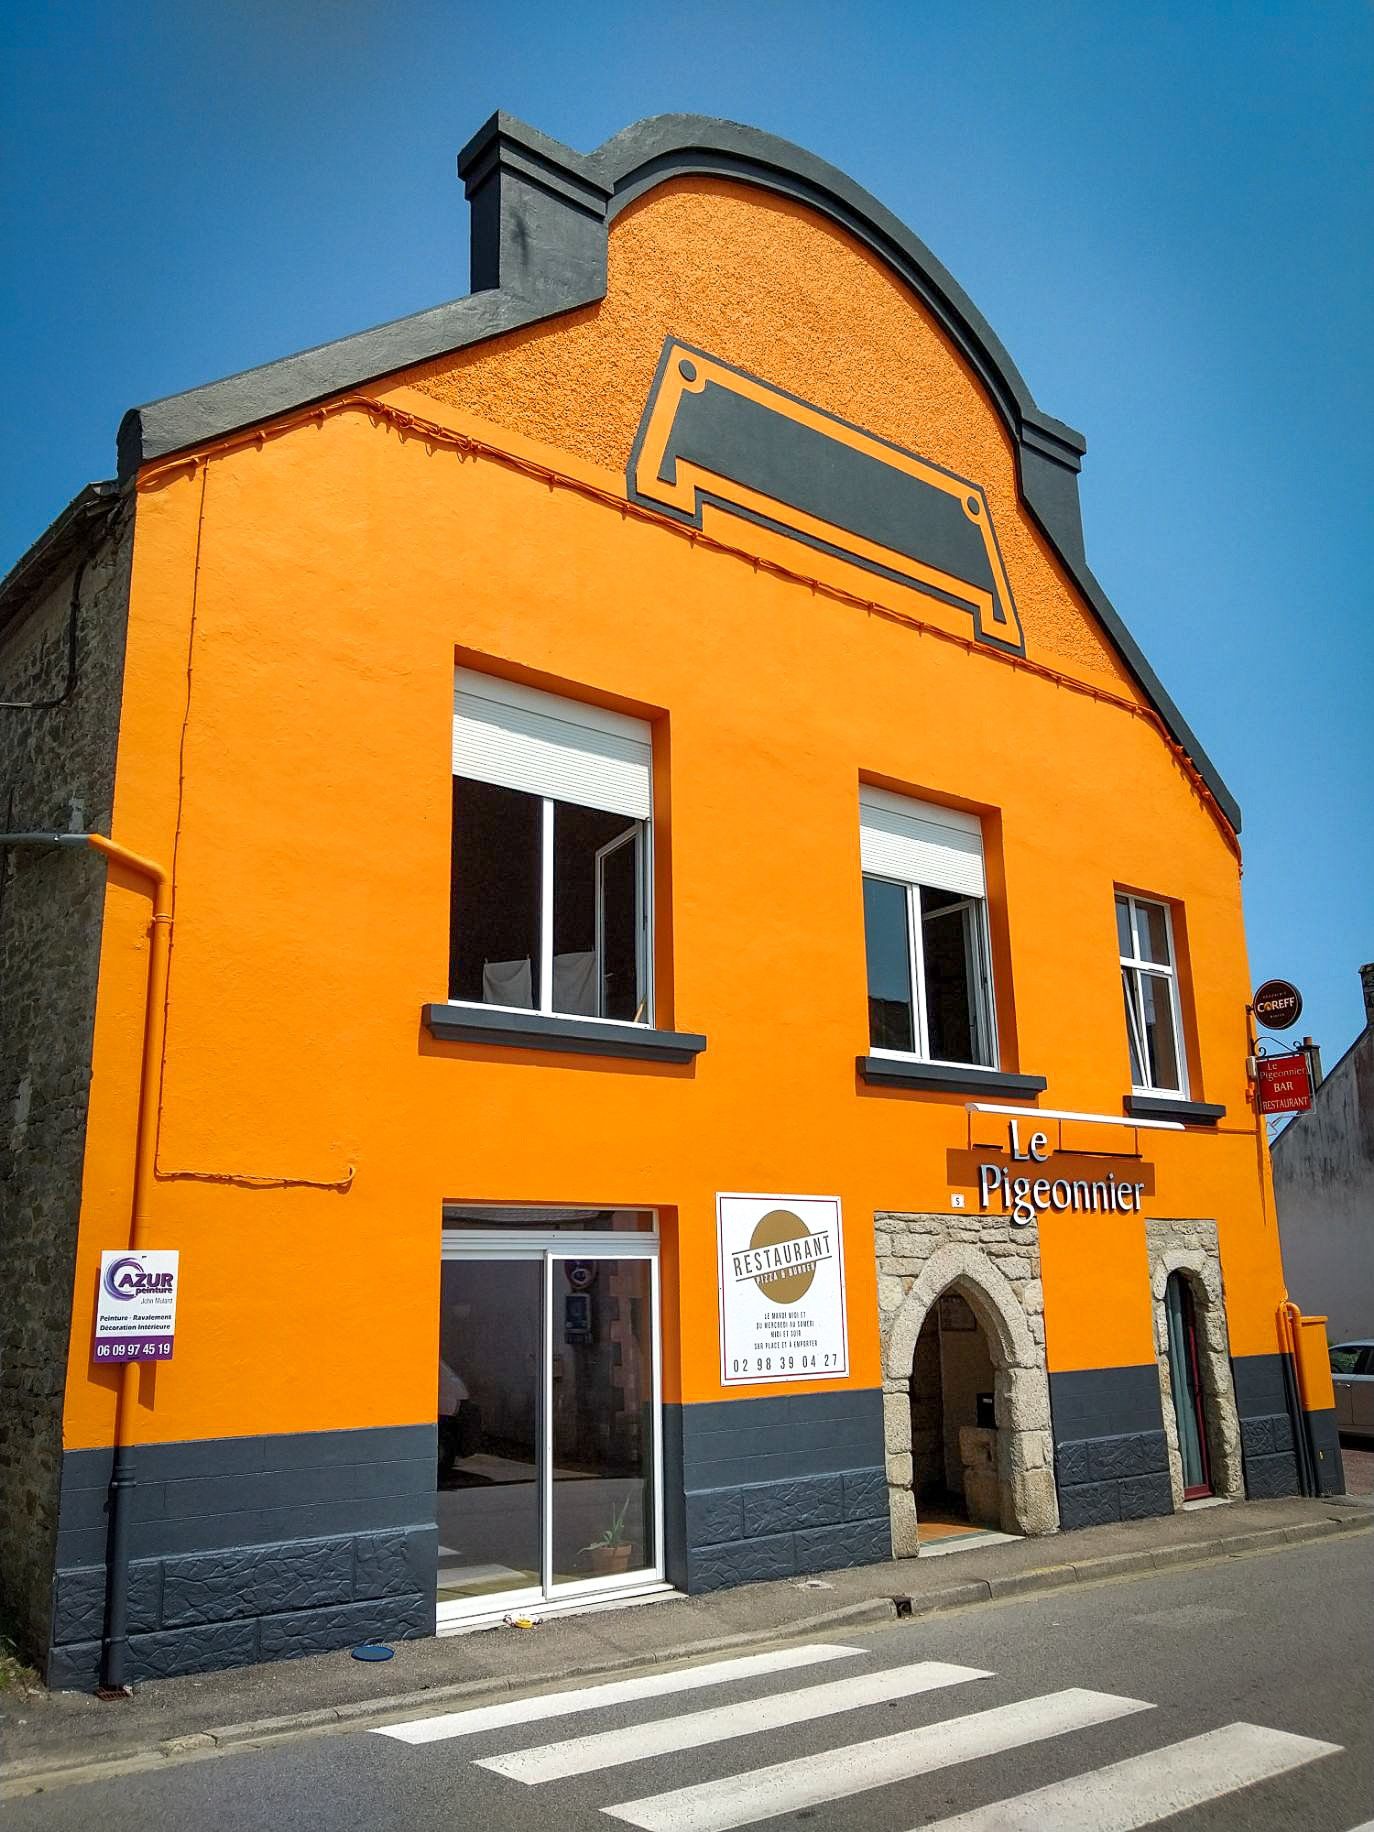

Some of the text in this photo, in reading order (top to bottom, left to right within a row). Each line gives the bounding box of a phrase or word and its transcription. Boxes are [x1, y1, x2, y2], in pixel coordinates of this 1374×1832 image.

[1257, 996, 1295, 1012] COREFF
[1260, 1068, 1305, 1081] Pigeonnier
[1273, 1081, 1294, 1093] BAR
[1262, 1096, 1309, 1110] RESTAURANT
[1009, 1119, 1049, 1162] Le
[979, 1164, 1144, 1225] Pigeonnier
[733, 1235, 830, 1277] RESTAURANT
[118, 1273, 174, 1288] AZUR
[755, 1272, 778, 1286] PIZZA
[788, 1261, 815, 1277] BURGER
[135, 1287, 173, 1296] peinture
[764, 1312, 770, 1320] LE
[97, 1343, 171, 1357] 06 09 97 45 19
[765, 1341, 780, 1349] PLACE
[781, 1341, 788, 1349] ET
[793, 1339, 818, 1348] EMPORTER
[733, 1353, 837, 1373] 02 98 39 04 27
